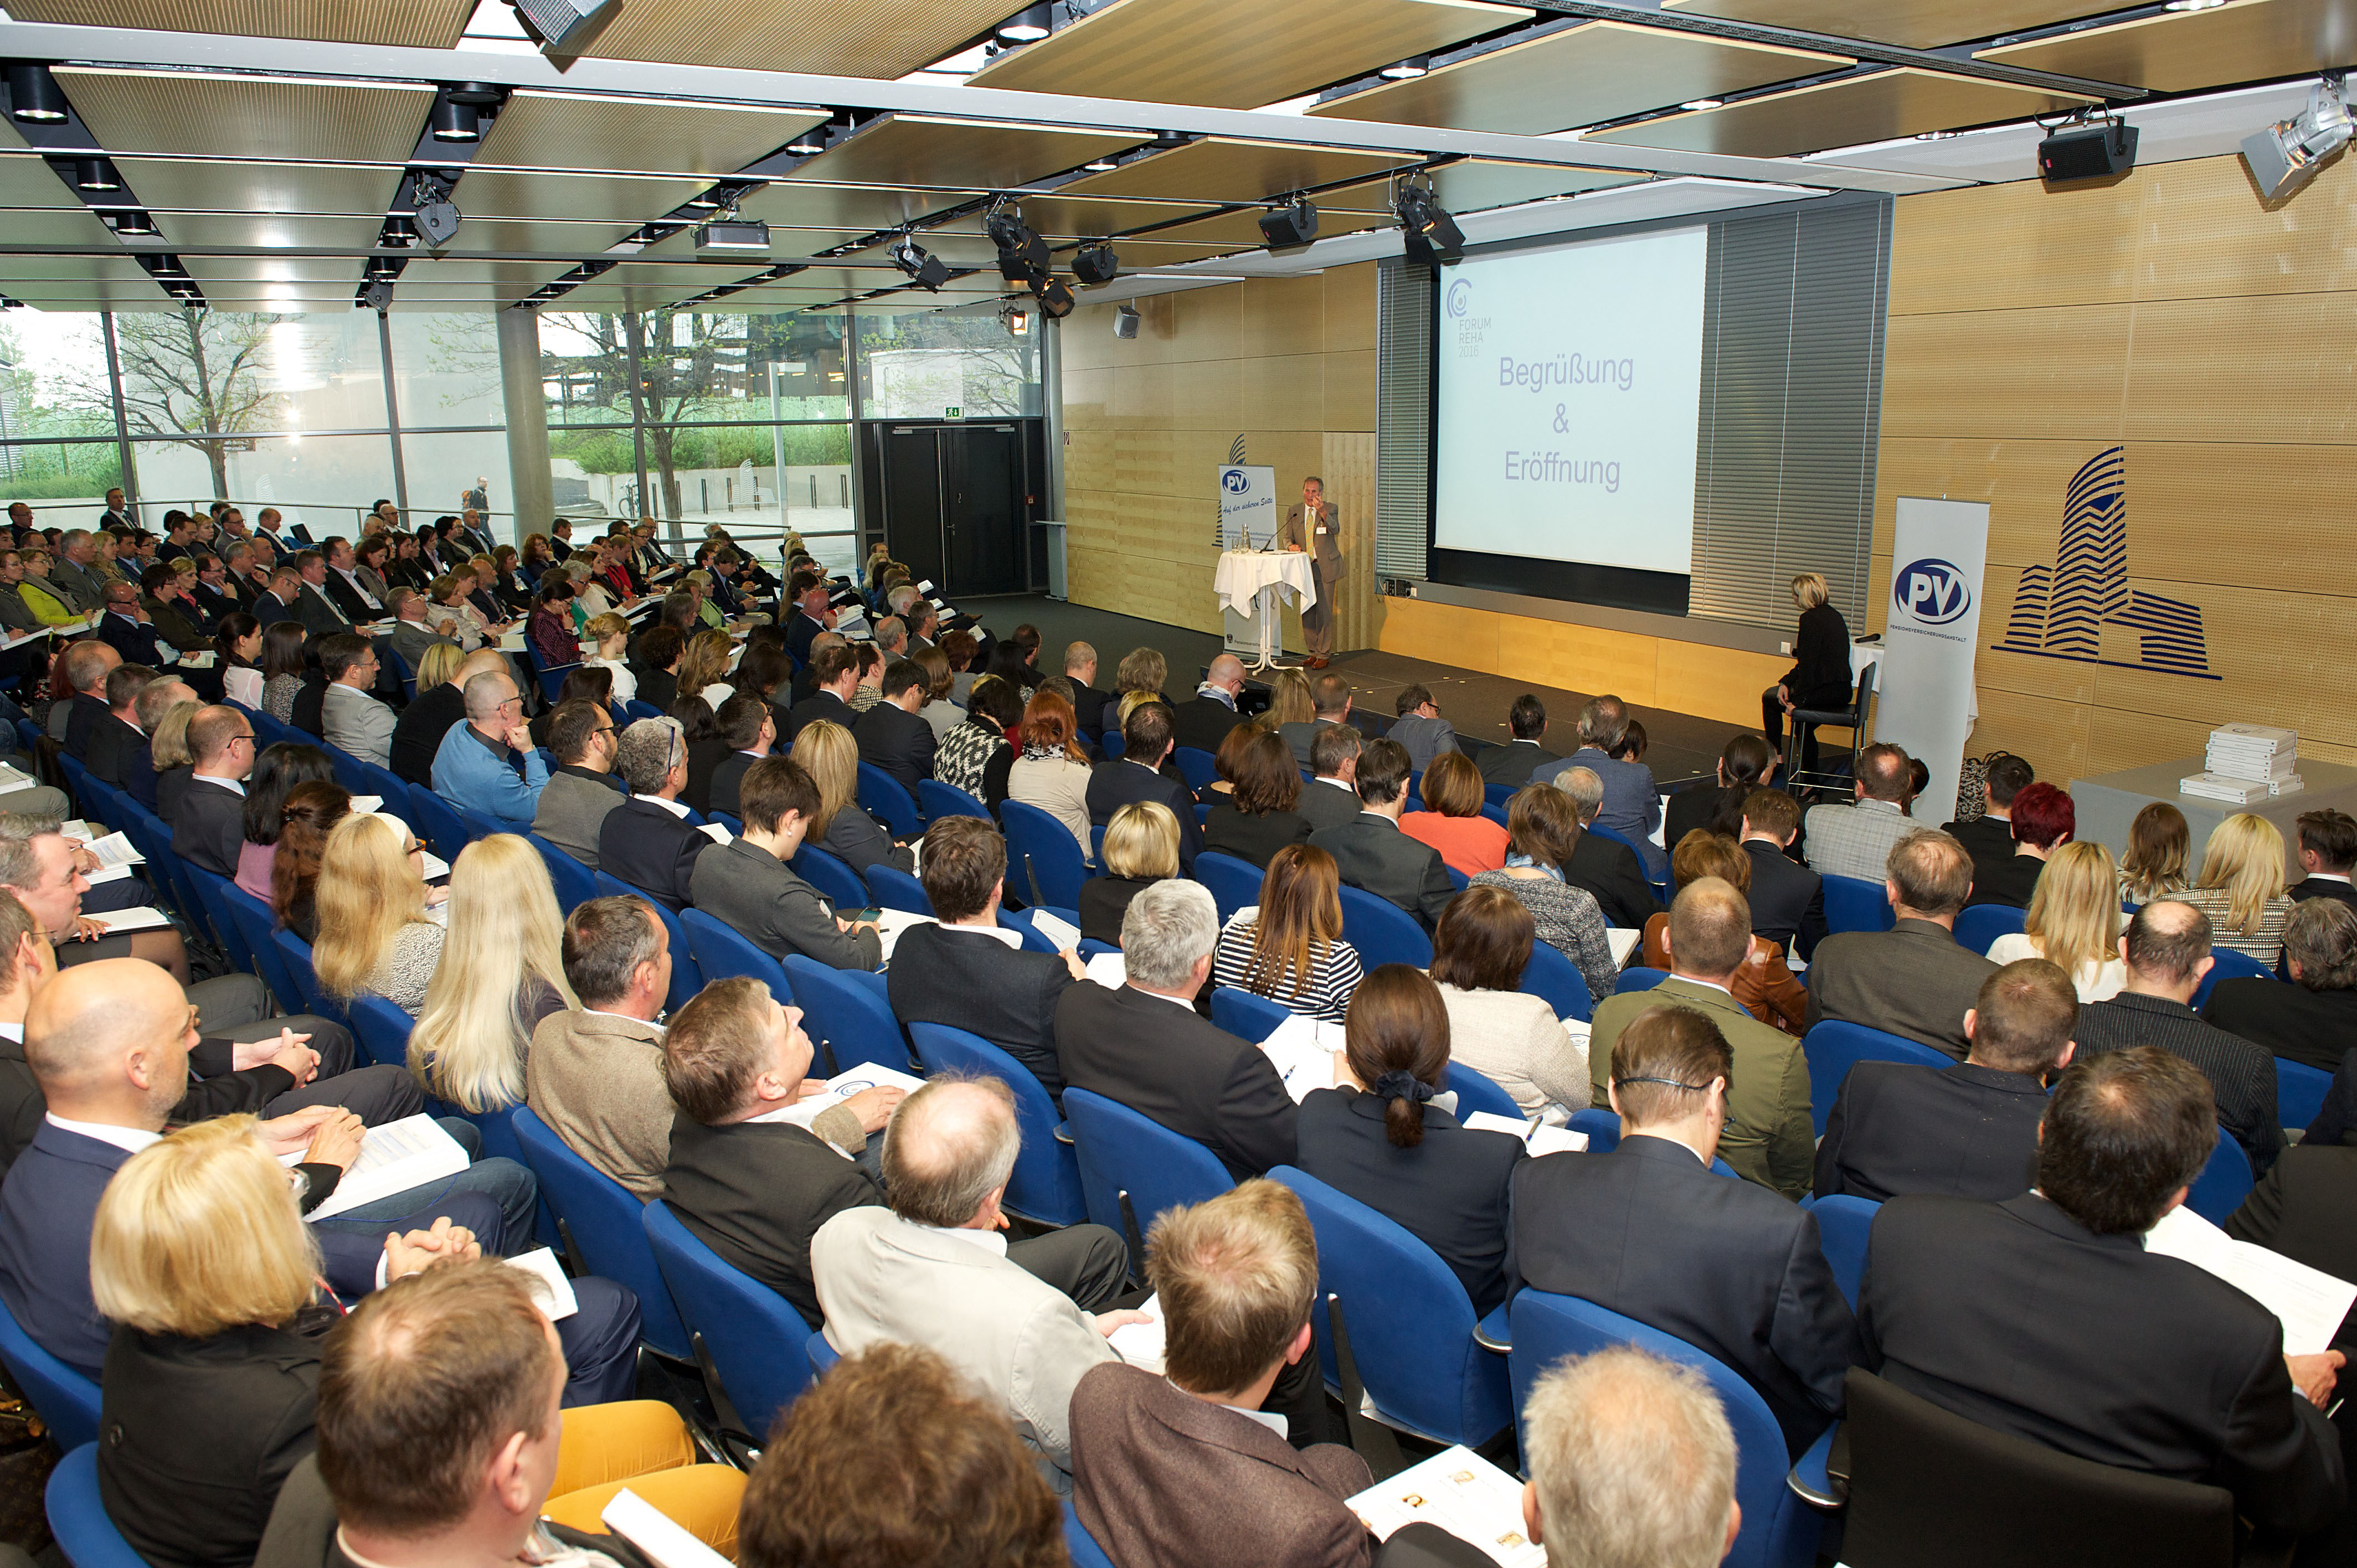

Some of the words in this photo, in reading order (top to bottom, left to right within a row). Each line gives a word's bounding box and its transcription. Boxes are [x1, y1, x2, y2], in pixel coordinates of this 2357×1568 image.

[1459, 317, 1491, 331] FORUM
[1459, 332, 1484, 344] REHA
[1458, 345, 1479, 357] 2016
[1500, 353, 1633, 393] Begrüßung
[1553, 403, 1569, 434] &
[1505, 451, 1620, 493] Eröffnung
[1227, 474, 1244, 492] PV
[1223, 506, 1232, 515] Auf
[1242, 501, 1259, 509] sicheren
[1890, 624, 1967, 642] PENSIONSVERSICHERUNGSANSTALT
